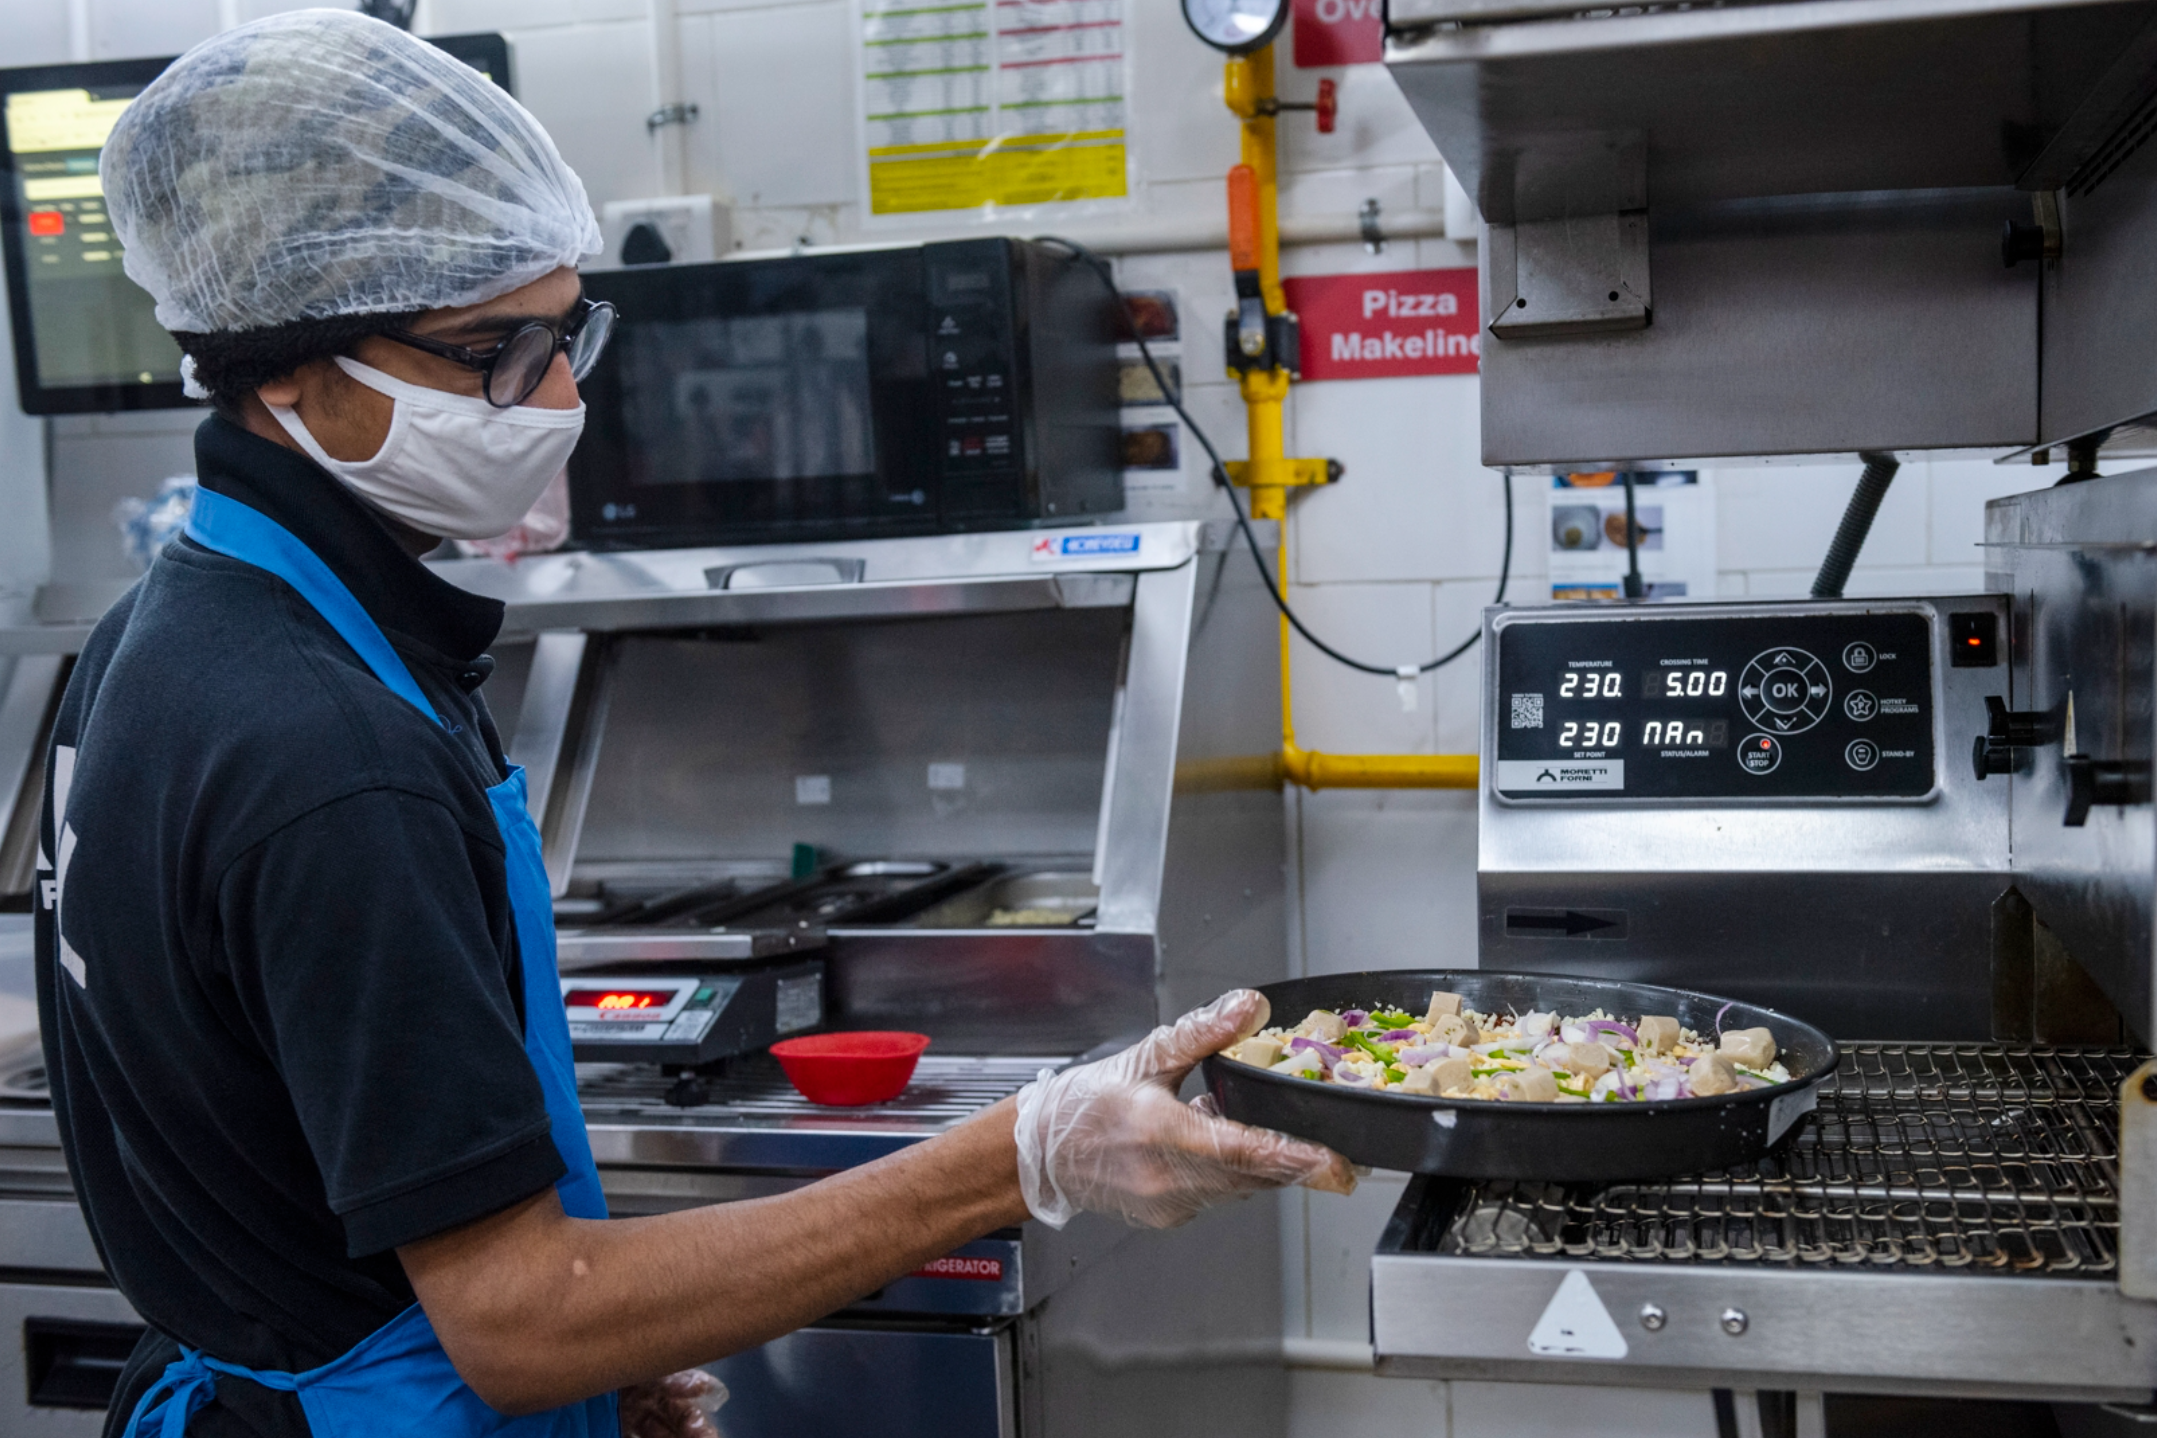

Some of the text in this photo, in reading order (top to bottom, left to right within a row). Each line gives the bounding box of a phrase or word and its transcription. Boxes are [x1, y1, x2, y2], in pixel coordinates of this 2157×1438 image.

[1362, 288, 1458, 319] Pizza
[1568, 660, 1613, 668] TEMPERATURE
[1660, 658, 1709, 666] CROSSING TIME
[1666, 671, 1727, 696] 5.00
[1771, 683, 1799, 698] OK
[1880, 706, 1919, 714] PROGRAMS
[1559, 722, 1621, 746] 230
[1661, 750, 1709, 758] STATUS/ALARM
[1749, 759, 1770, 767] STOP
